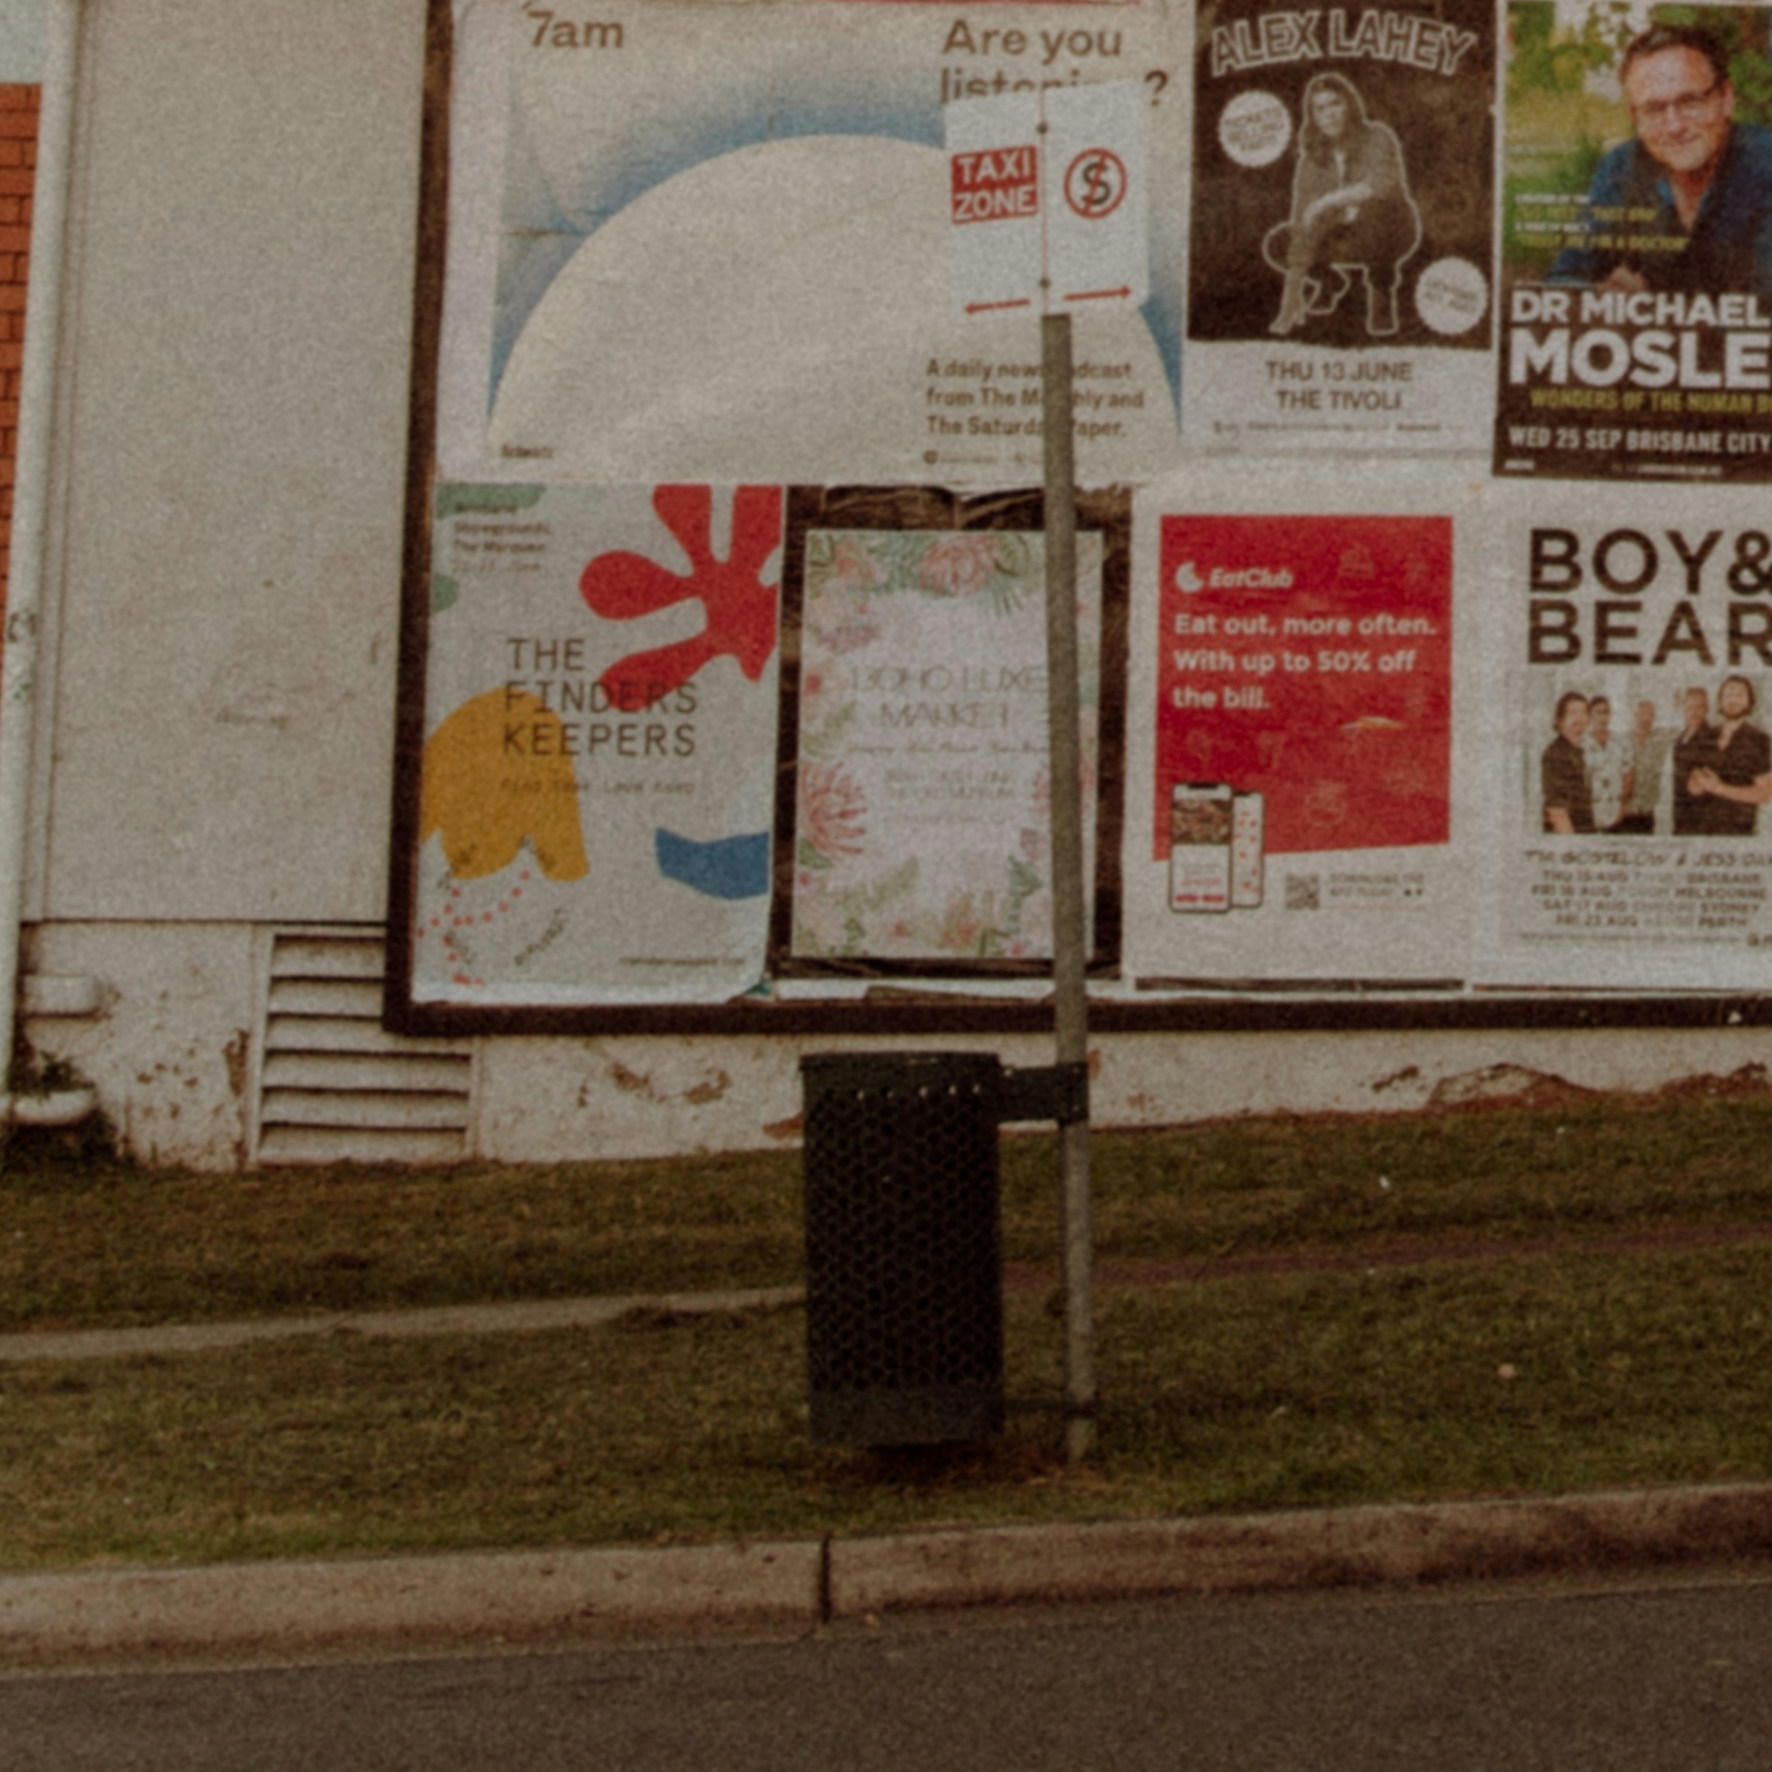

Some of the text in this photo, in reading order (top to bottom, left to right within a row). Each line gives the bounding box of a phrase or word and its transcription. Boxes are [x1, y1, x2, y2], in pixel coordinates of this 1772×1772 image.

[527, 11, 624, 50] 7am
[943, 19, 1122, 67] Are you
[1211, 8, 1479, 78] ALEX LAHEY
[956, 149, 1031, 185] TAXI
[954, 185, 1035, 220] ZONE
[1512, 291, 1569, 323] DR
[926, 358, 940, 377] A
[945, 359, 992, 382] daily
[1265, 360, 1414, 382] THU 13 JUNE
[926, 387, 975, 407] from
[980, 387, 1016, 407] The
[1108, 390, 1145, 408] and
[1275, 390, 1403, 411] THE TIVOLI
[1529, 388, 1618, 411] WONDERS
[1621, 392, 1646, 411] OF
[1650, 392, 1683, 412] THE
[1686, 393, 1753, 413] HUMAN
[926, 415, 963, 435] The
[1509, 426, 1552, 449] WED
[1555, 428, 1580, 449] 25
[1584, 429, 1623, 450] SEP
[1626, 430, 1722, 452] BRISBANE
[1726, 432, 1772, 453] CITY
[1208, 566, 1296, 590] EatClub
[1174, 612, 1440, 637] Eat out, more often.
[505, 637, 586, 671] THE
[1173, 649, 1418, 678] With up to 50% off
[503, 680, 699, 714] FINDERS
[1172, 686, 1272, 708] the bill.
[502, 722, 697, 757] KEEPERS
